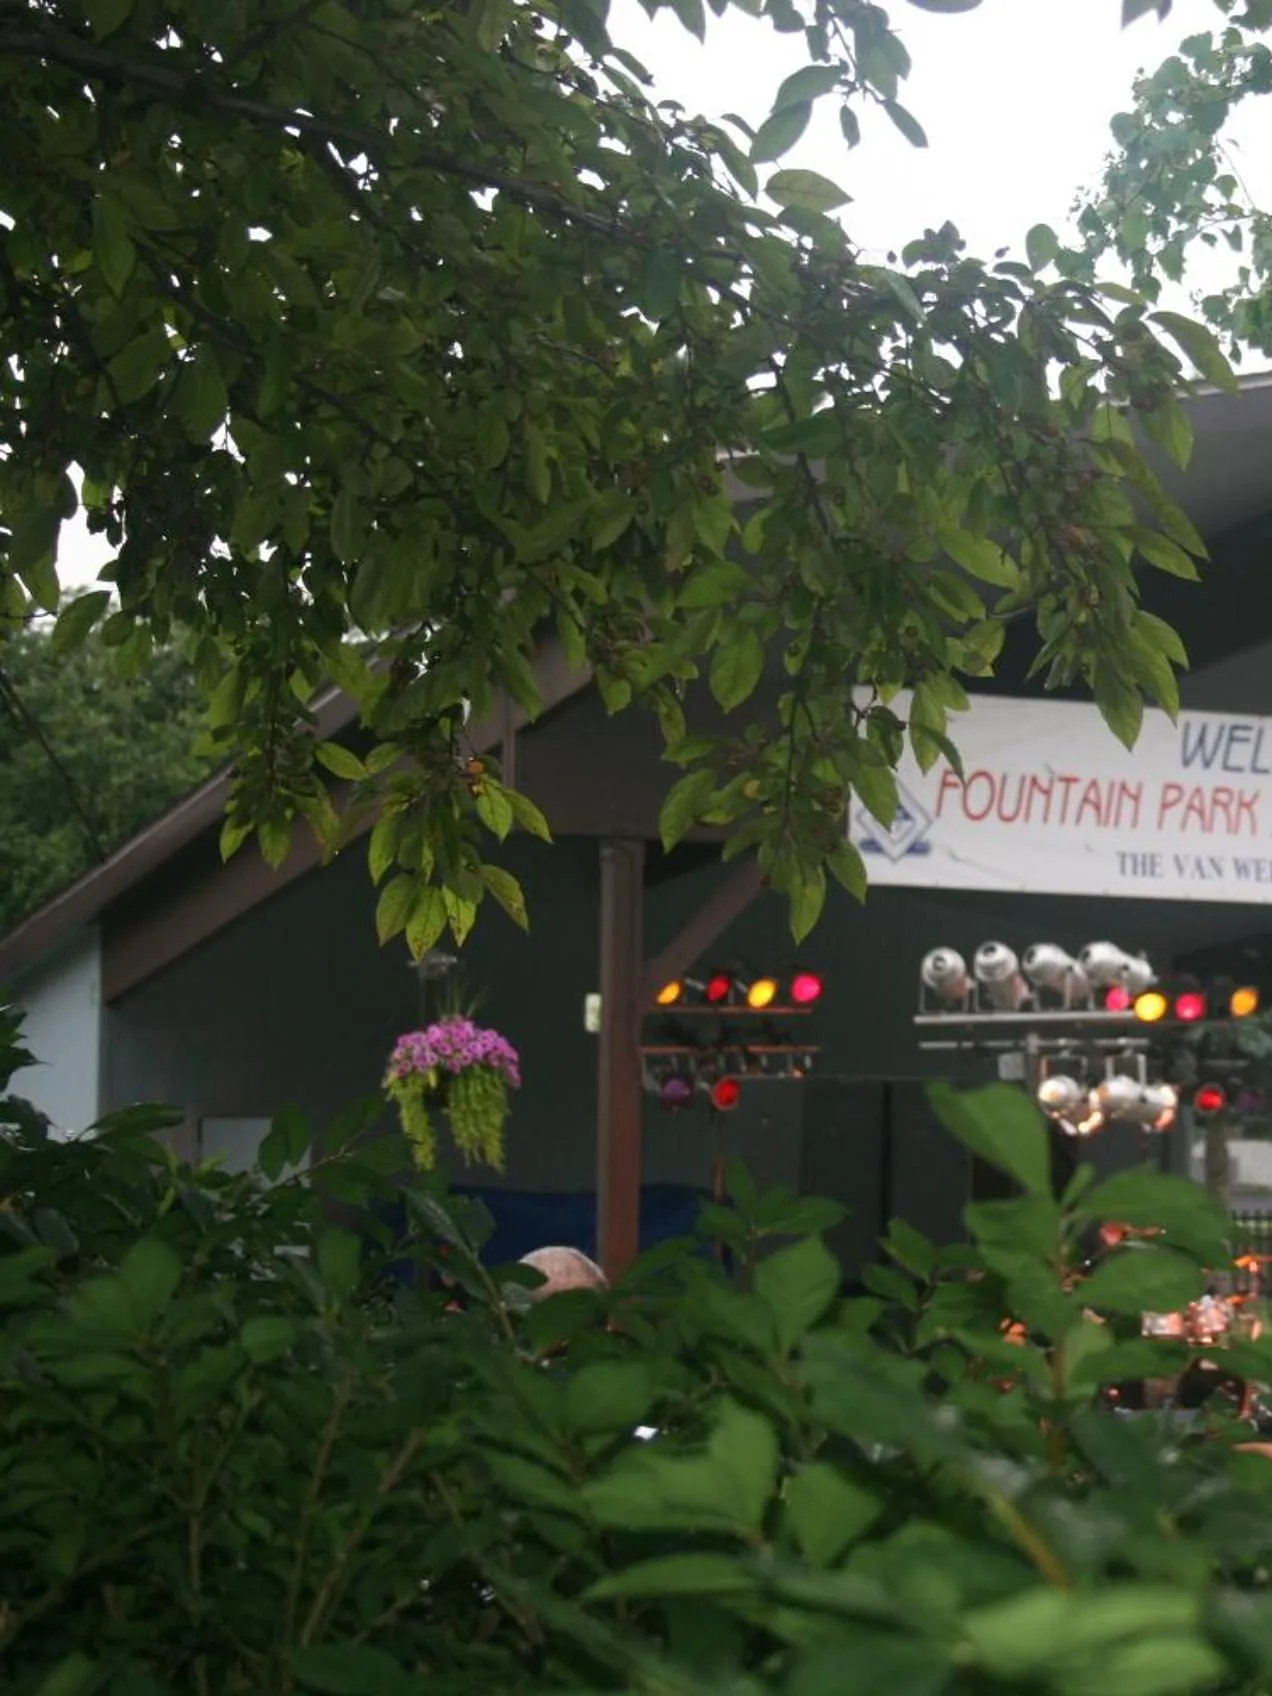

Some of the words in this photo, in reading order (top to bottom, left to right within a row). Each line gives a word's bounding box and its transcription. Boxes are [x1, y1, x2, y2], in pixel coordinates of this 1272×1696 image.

[935, 769, 1144, 830] FOUNTAIN
[1157, 782, 1260, 838] PARK
[1117, 851, 1164, 879] THE
[1174, 853, 1225, 881] VAN
